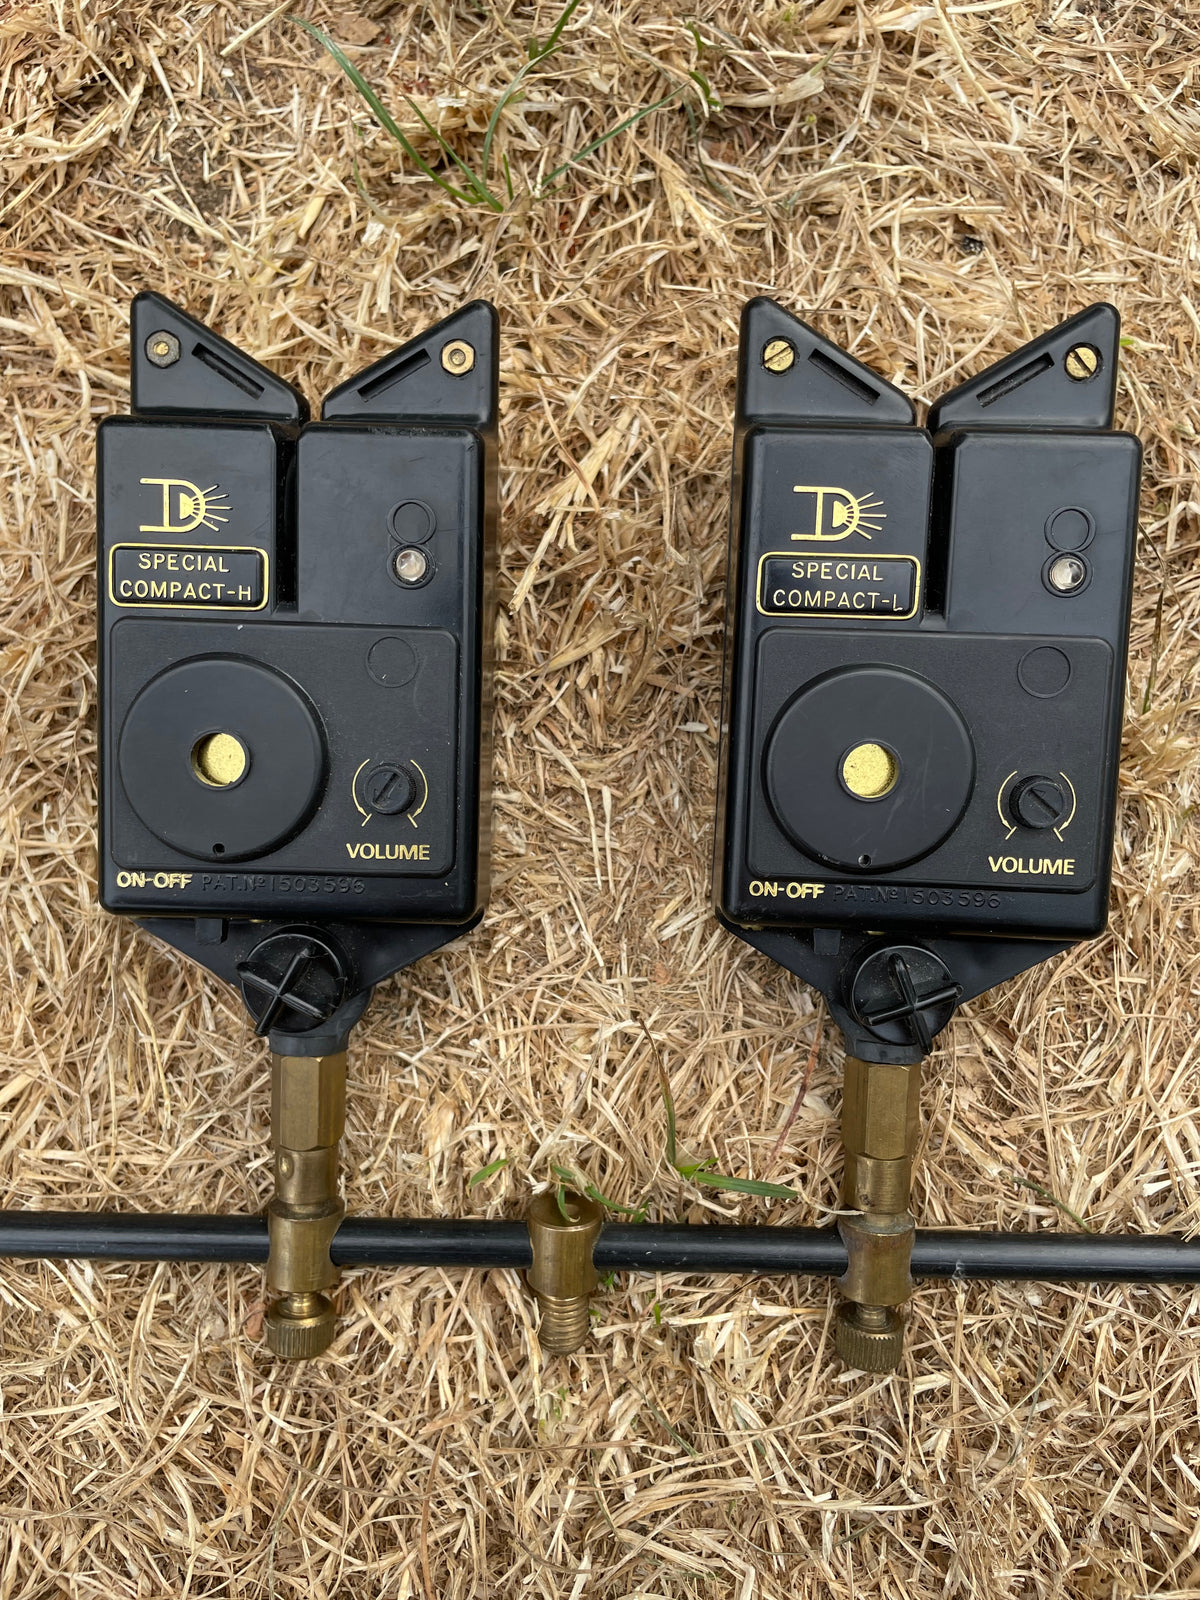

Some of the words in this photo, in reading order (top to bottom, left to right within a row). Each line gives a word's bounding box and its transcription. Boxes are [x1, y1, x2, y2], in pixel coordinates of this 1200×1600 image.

[138, 552, 230, 573] SPECIAL
[791, 561, 884, 581] SPECIAL
[119, 579, 251, 601] COMPACT-H
[772, 589, 903, 612] COMPACT-L
[346, 843, 430, 861] VOLUME
[988, 856, 1076, 876] VOLUME
[116, 871, 193, 889] ON-OFF
[748, 880, 825, 899] ON-OFF
